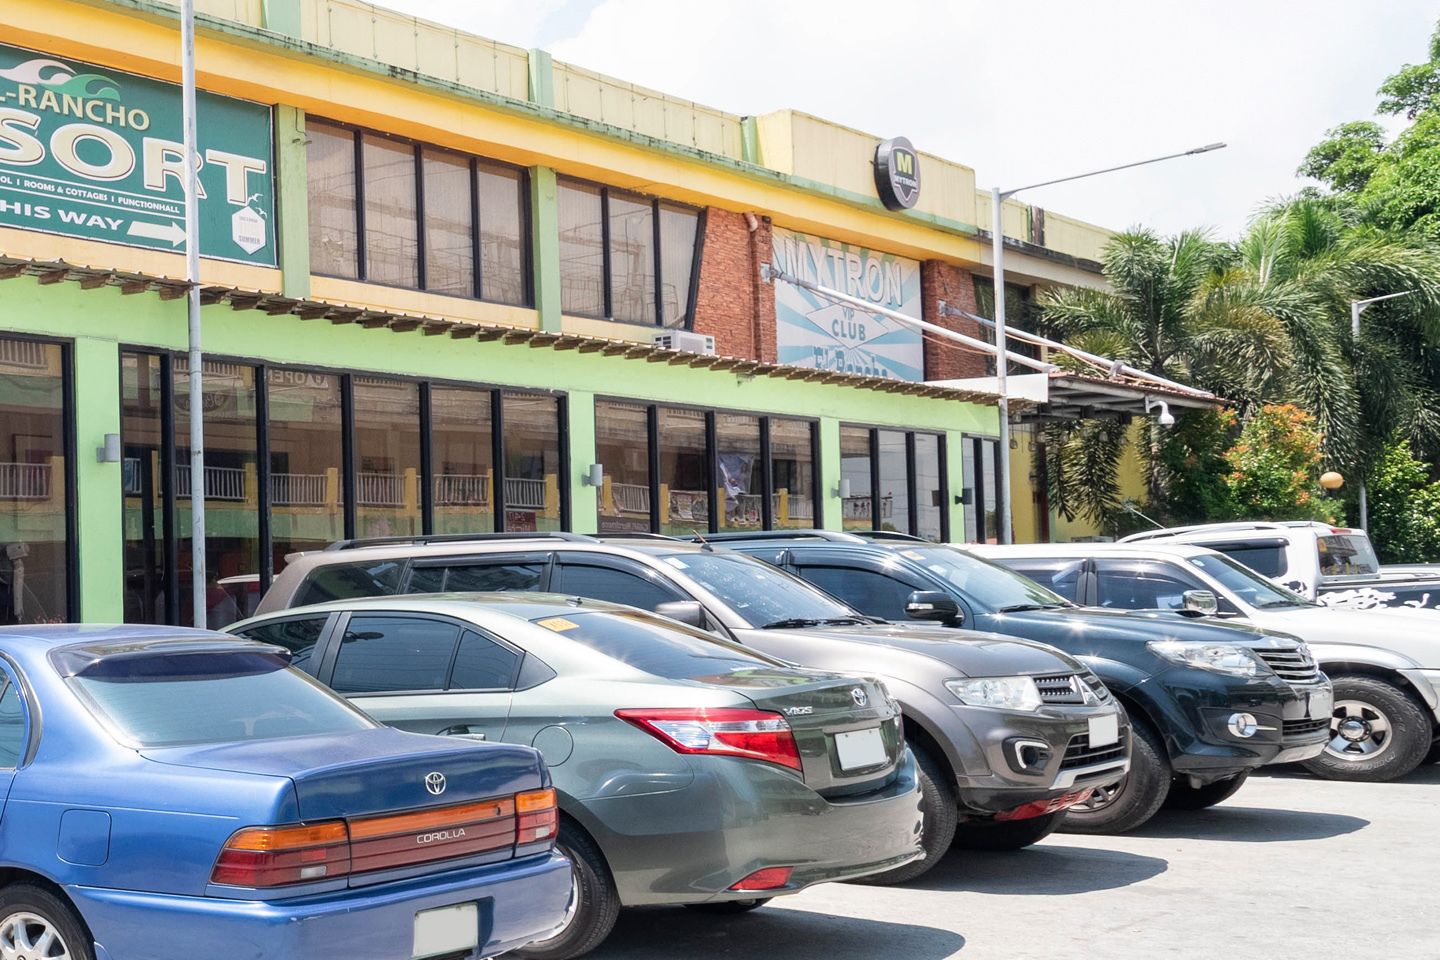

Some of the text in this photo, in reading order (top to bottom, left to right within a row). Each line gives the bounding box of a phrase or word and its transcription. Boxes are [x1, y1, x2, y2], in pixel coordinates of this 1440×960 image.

[896, 151, 912, 175] M
[23, 180, 55, 193] ROOMS
[57, 186, 64, 194] &
[66, 186, 108, 202] COTTAGES
[118, 196, 180, 214] FUNCTIONHALL
[58, 209, 124, 230] WAY
[832, 319, 866, 341] CLUB
[783, 705, 813, 715] VIOS
[416, 828, 465, 844] COROLLA
